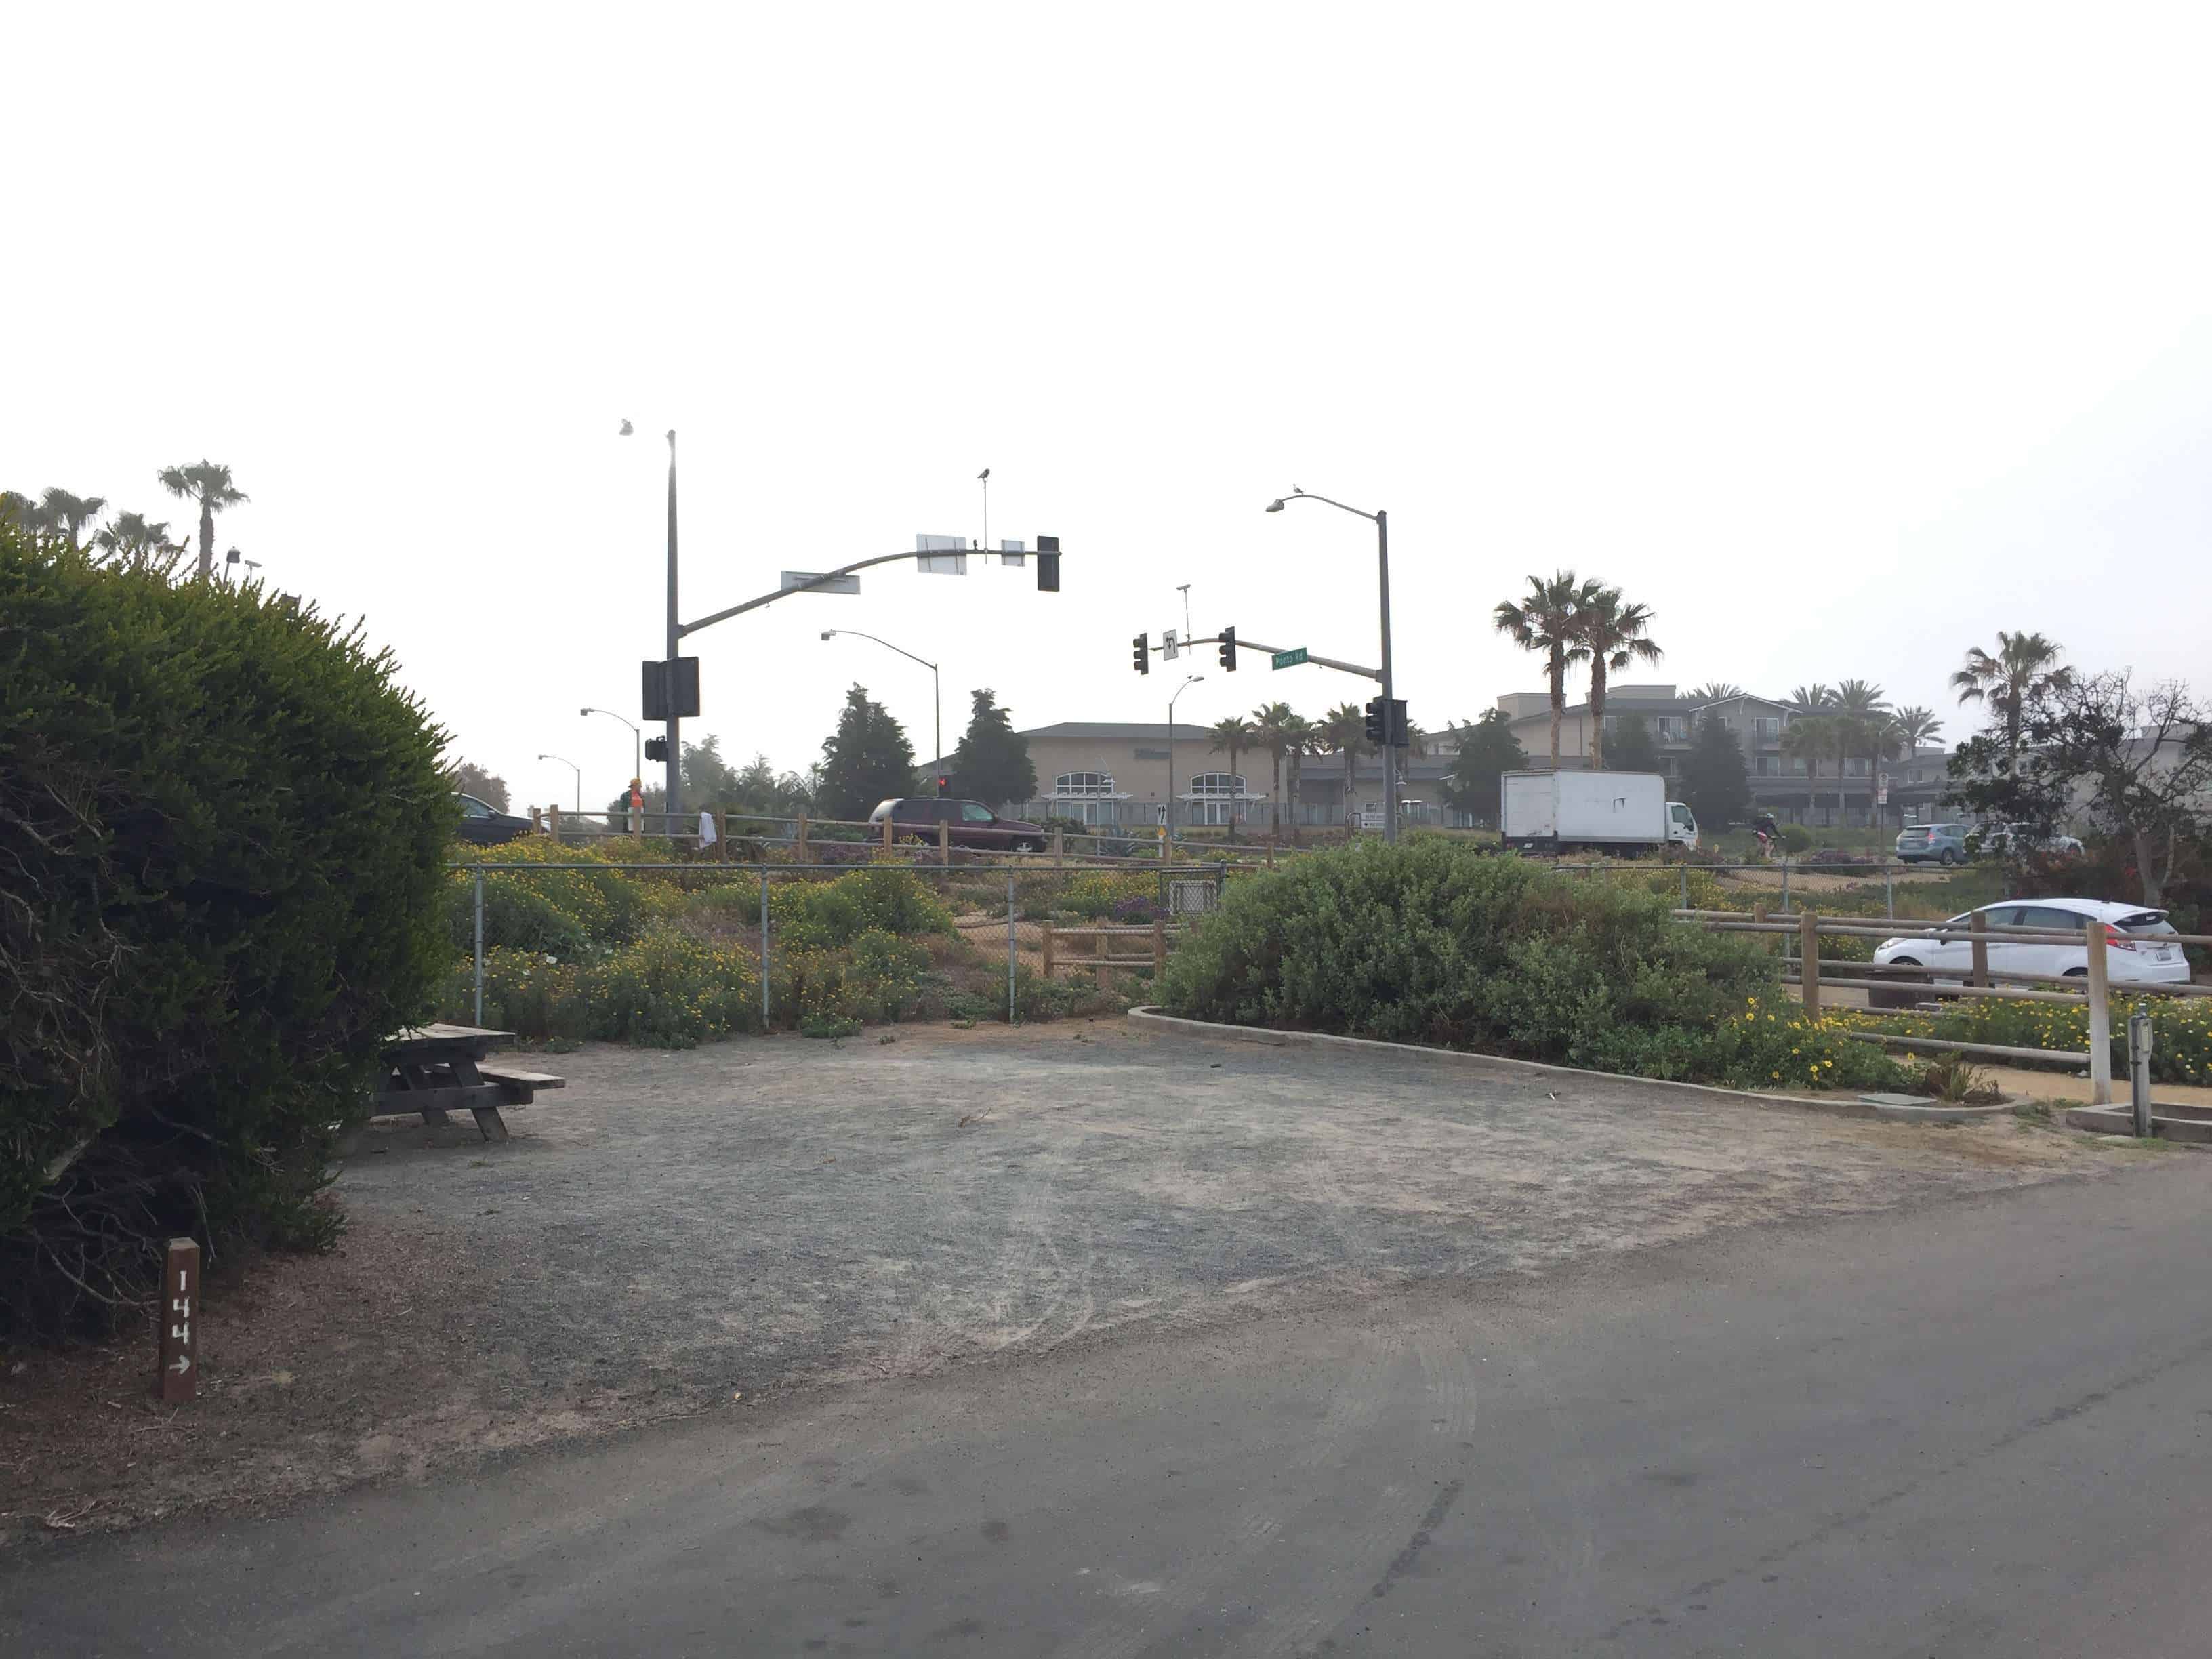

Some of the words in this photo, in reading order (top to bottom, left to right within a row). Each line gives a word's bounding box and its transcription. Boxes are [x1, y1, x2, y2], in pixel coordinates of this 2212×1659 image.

[1275, 655, 1293, 666] Ponto
[1295, 651, 1303, 661] Rd
[172, 1270, 190, 1345] 144
